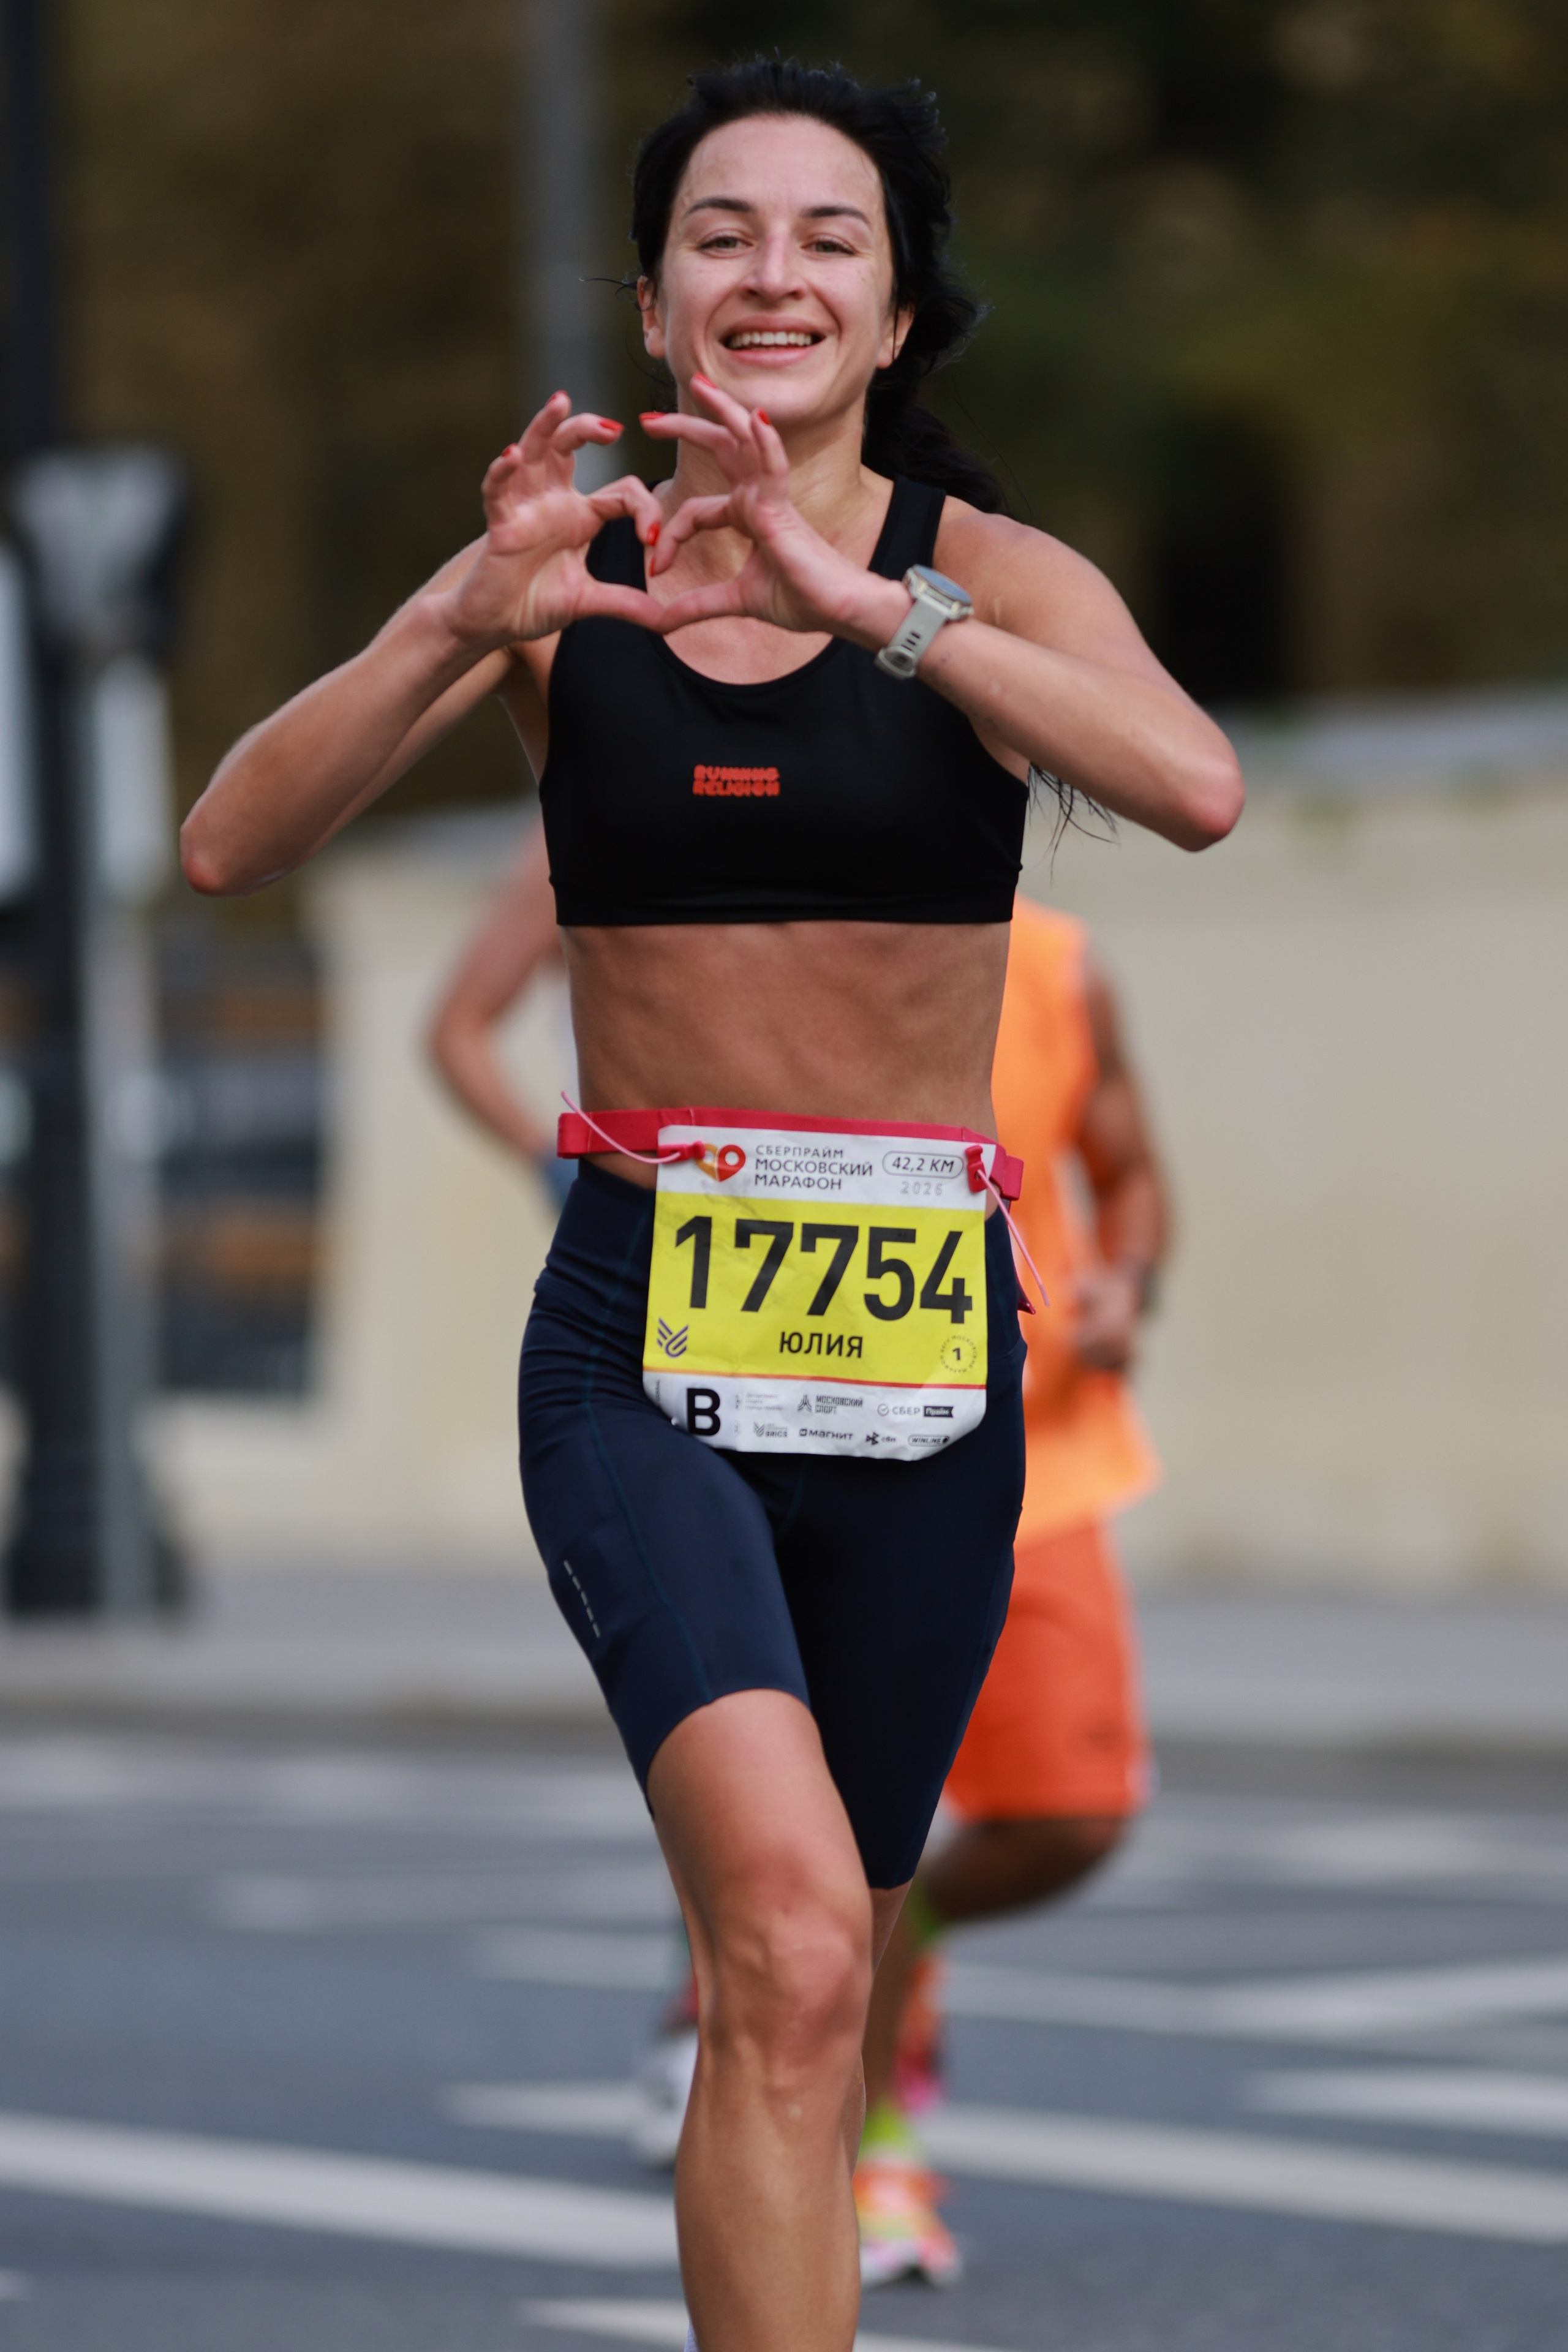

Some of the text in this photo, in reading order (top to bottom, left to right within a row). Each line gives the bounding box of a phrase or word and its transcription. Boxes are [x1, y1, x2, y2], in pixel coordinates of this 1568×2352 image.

[756, 1144, 844, 1159] СБЕРПРАЙМ
[755, 1158, 873, 1177] МОСКОВСКИЙ
[891, 1156, 925, 1173] 42,2
[755, 1174, 842, 1190] МАРАФОН
[900, 1180, 943, 1196] 2026
[675, 1216, 973, 1324] 17754
[780, 1332, 864, 1359] ЮЛИЯ
[952, 1347, 961, 1361] 1
[815, 1395, 863, 1408] МОСКОВСКИЙ
[815, 1404, 837, 1414] СПОРТ
[892, 1406, 921, 1415] СБЕР
